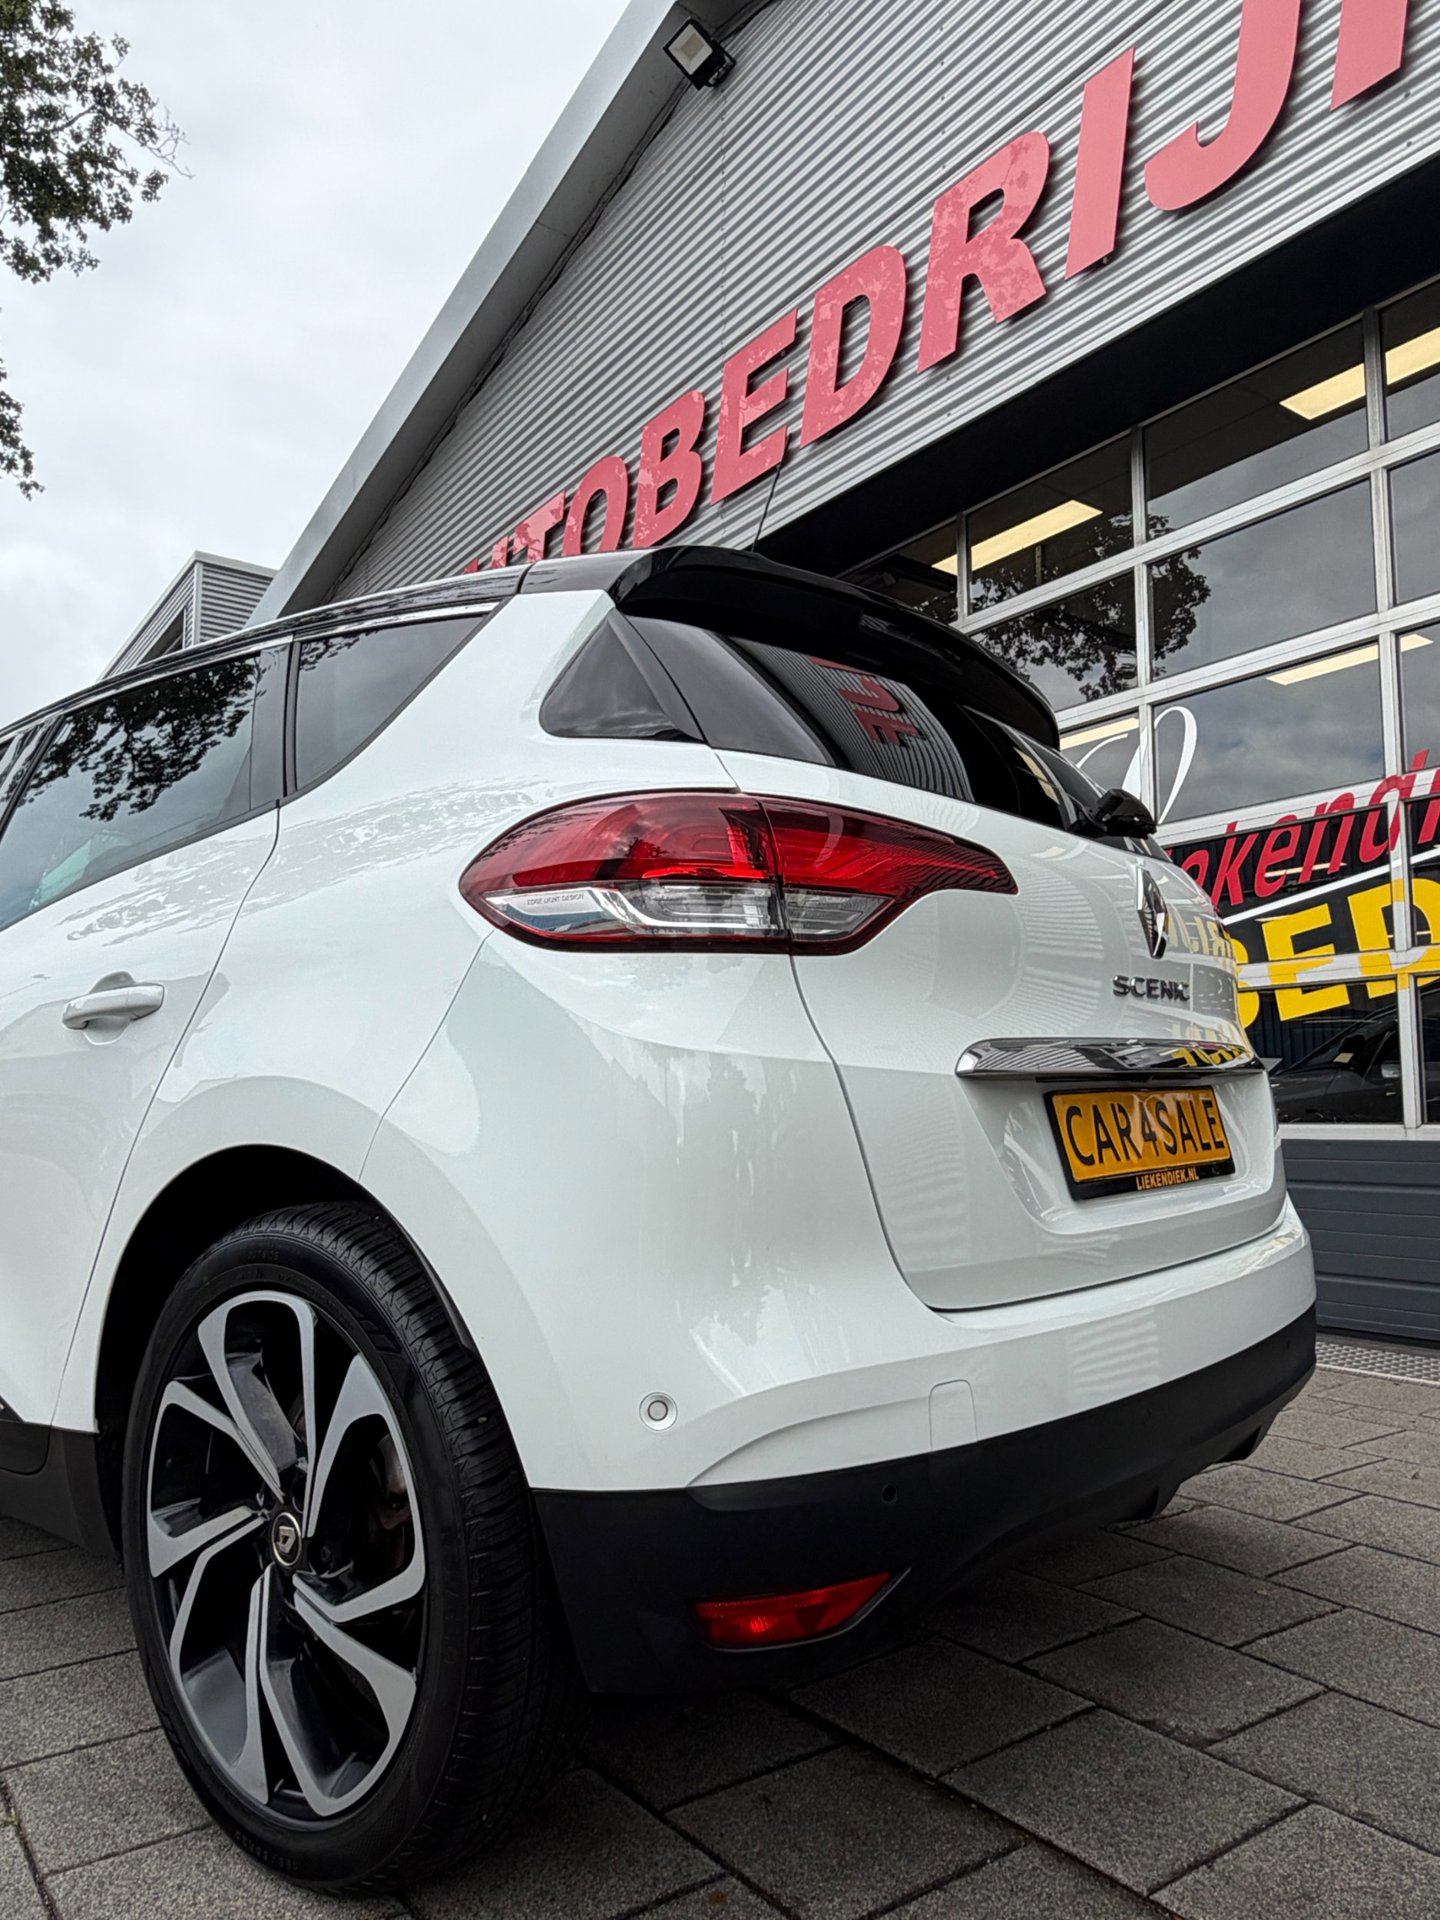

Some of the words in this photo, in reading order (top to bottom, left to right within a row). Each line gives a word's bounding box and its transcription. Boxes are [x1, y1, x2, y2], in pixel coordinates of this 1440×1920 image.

[463, 0, 1409, 573] TOBEDRIJ
[1112, 974, 1190, 1002] SCENIC
[1135, 1167, 1200, 1191] LIEKENDIEK.NL
